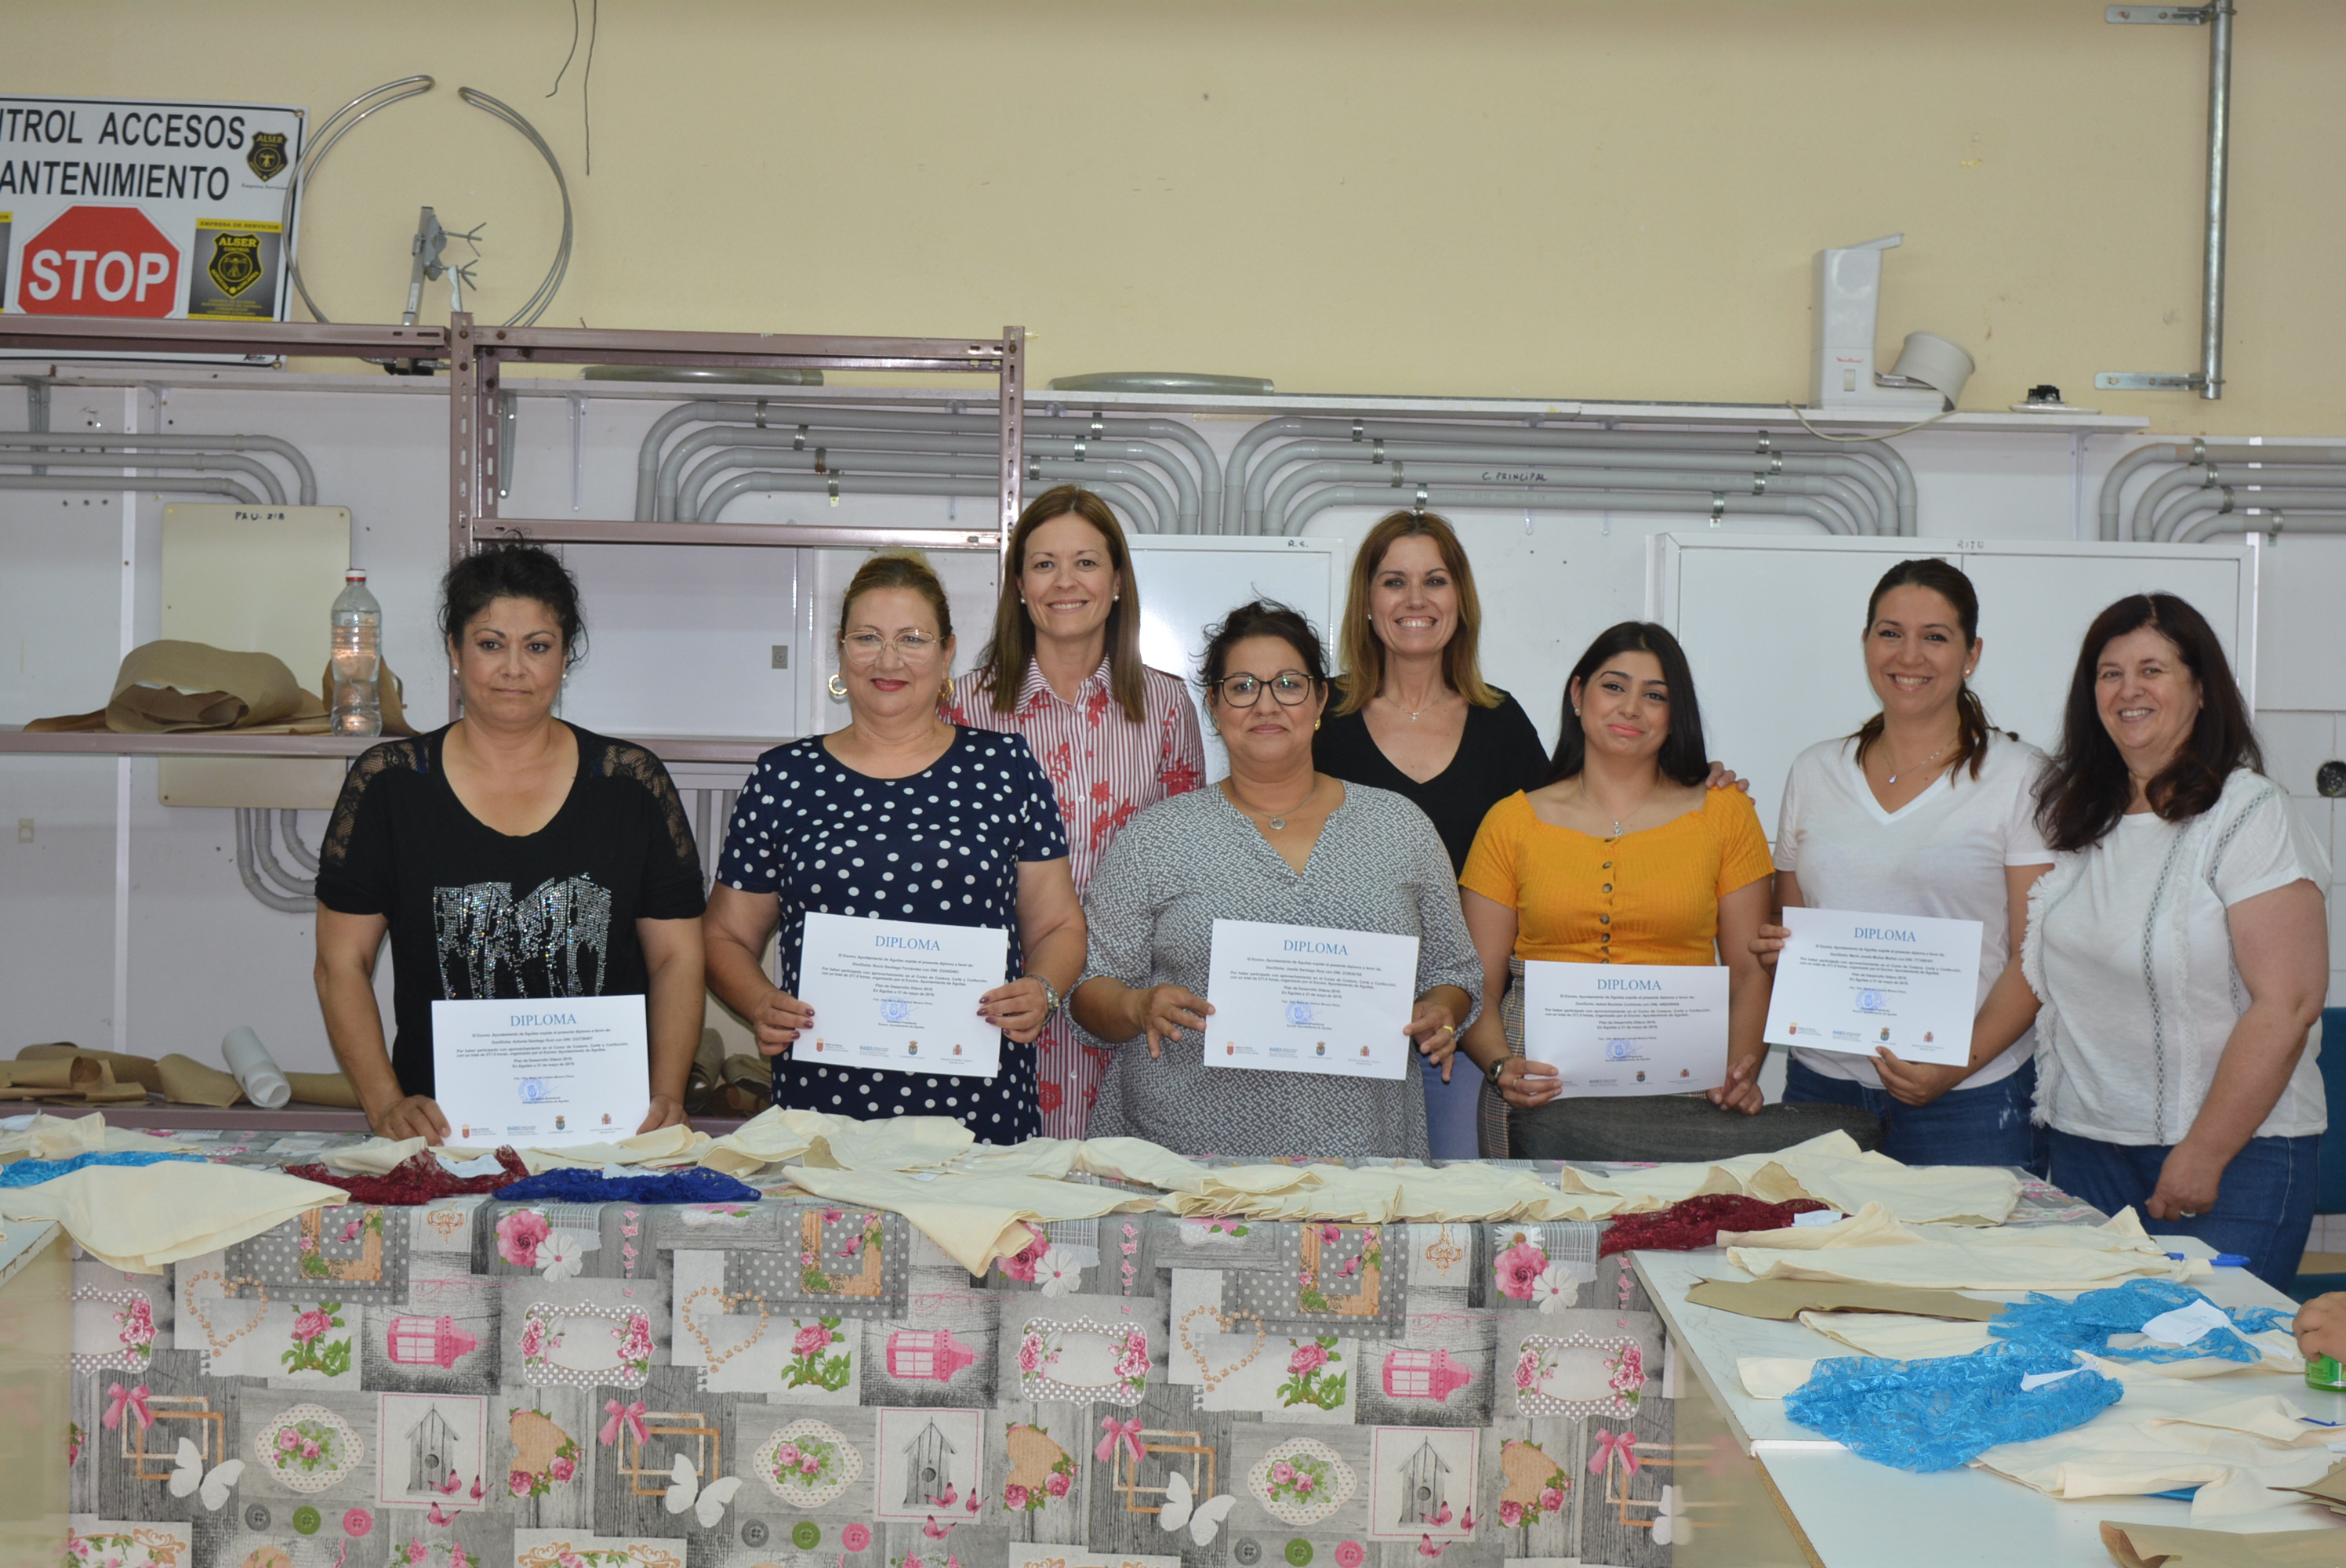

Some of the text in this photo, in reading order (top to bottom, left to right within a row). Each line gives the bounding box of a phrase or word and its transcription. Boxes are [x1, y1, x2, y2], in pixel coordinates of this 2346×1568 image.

[0, 108, 245, 150] TROL ACCESOS
[219, 237, 257, 247] ALSER
[28, 249, 170, 302] STOP
[1854, 927, 1916, 942] DIPLOMA
[875, 935, 941, 951] DIPLOMA
[1284, 940, 1348, 956] DIPLOMA
[1597, 979, 1662, 990] DIPLOMA
[510, 1014, 577, 1026] DIPLOMA
